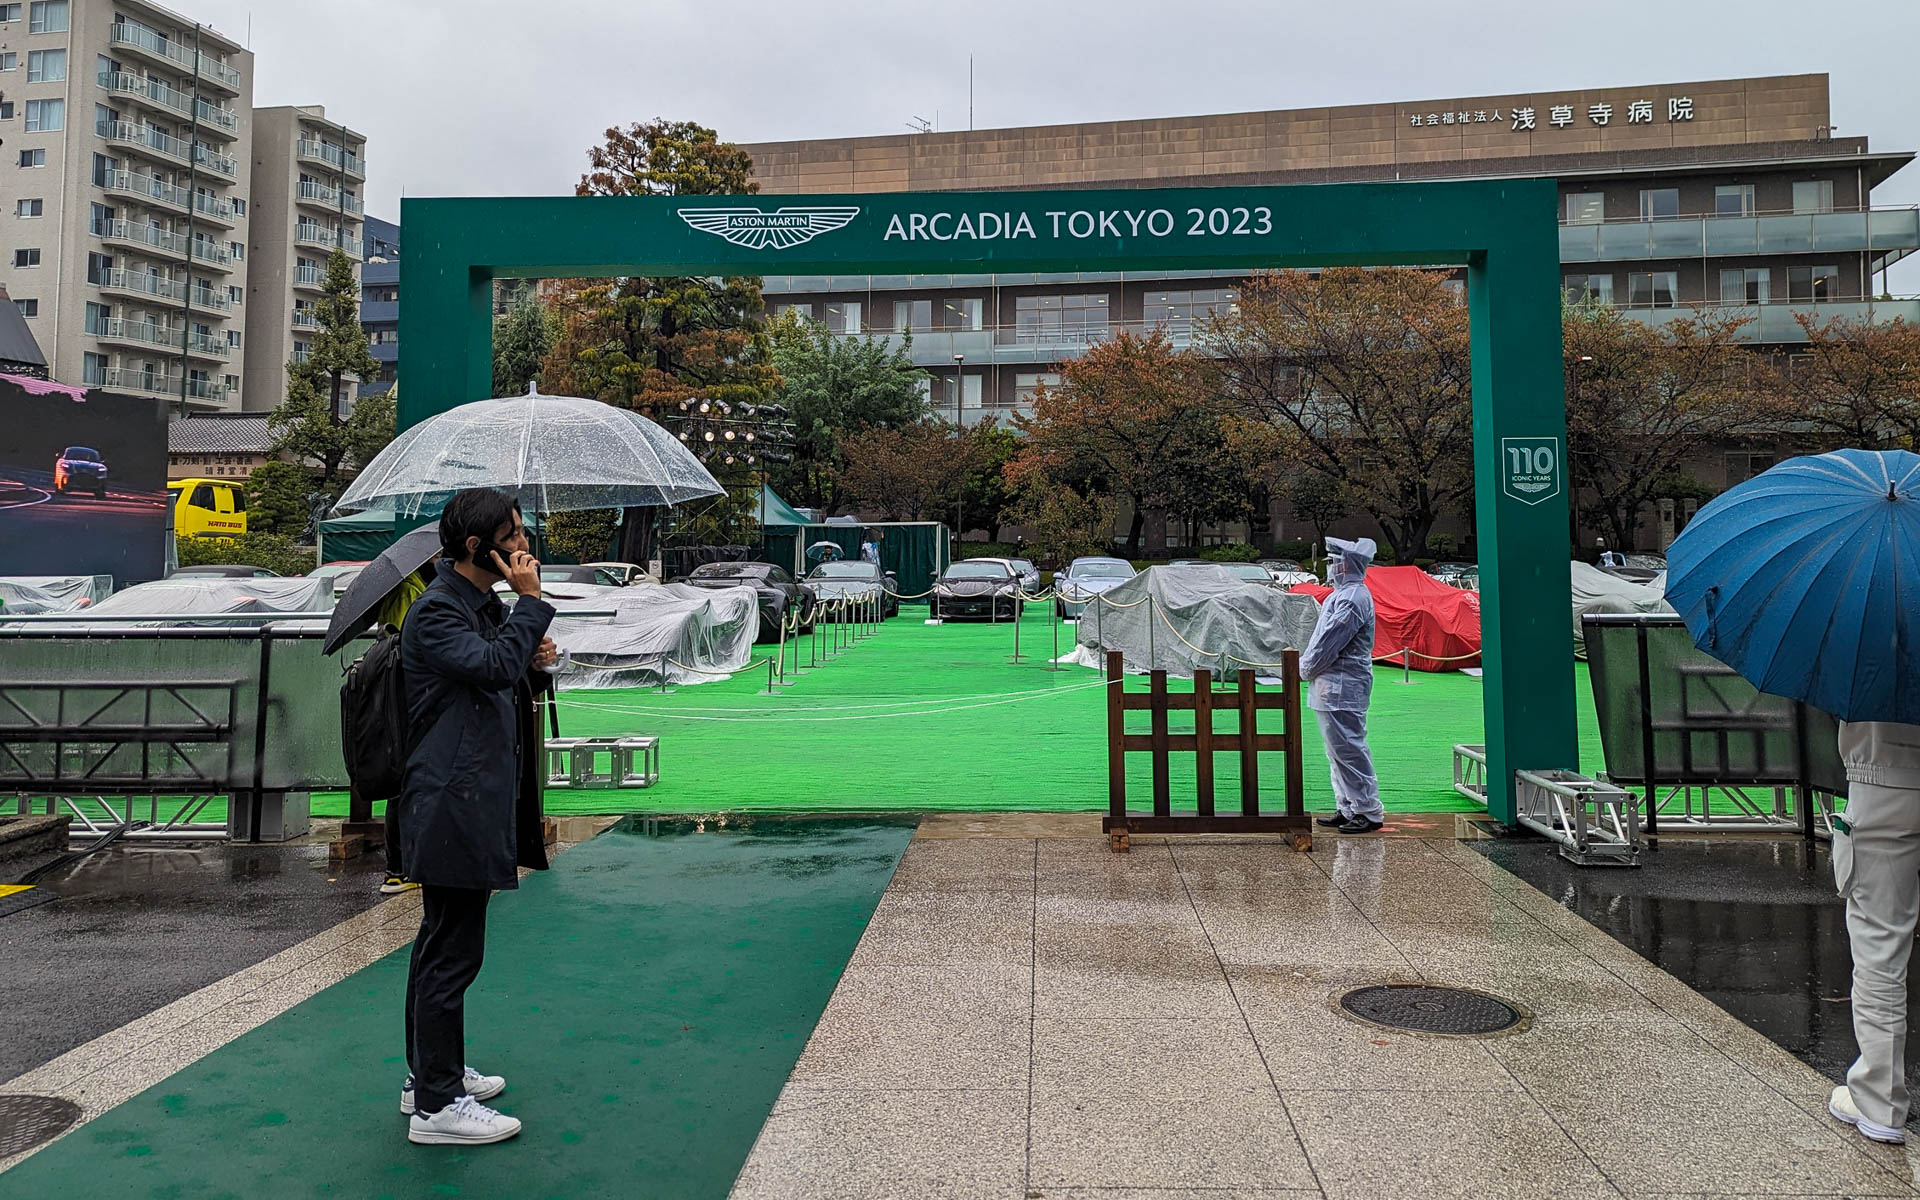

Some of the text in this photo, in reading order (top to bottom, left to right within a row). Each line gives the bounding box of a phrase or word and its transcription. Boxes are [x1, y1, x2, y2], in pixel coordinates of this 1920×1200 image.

[1410, 97, 1694, 130] 社会福祉法人 浅草寺病院
[730, 217, 807, 227] ASTON MARTIN
[883, 206, 1273, 241] ARCADIA TOKYO 2023
[1507, 446, 1554, 474] 110
